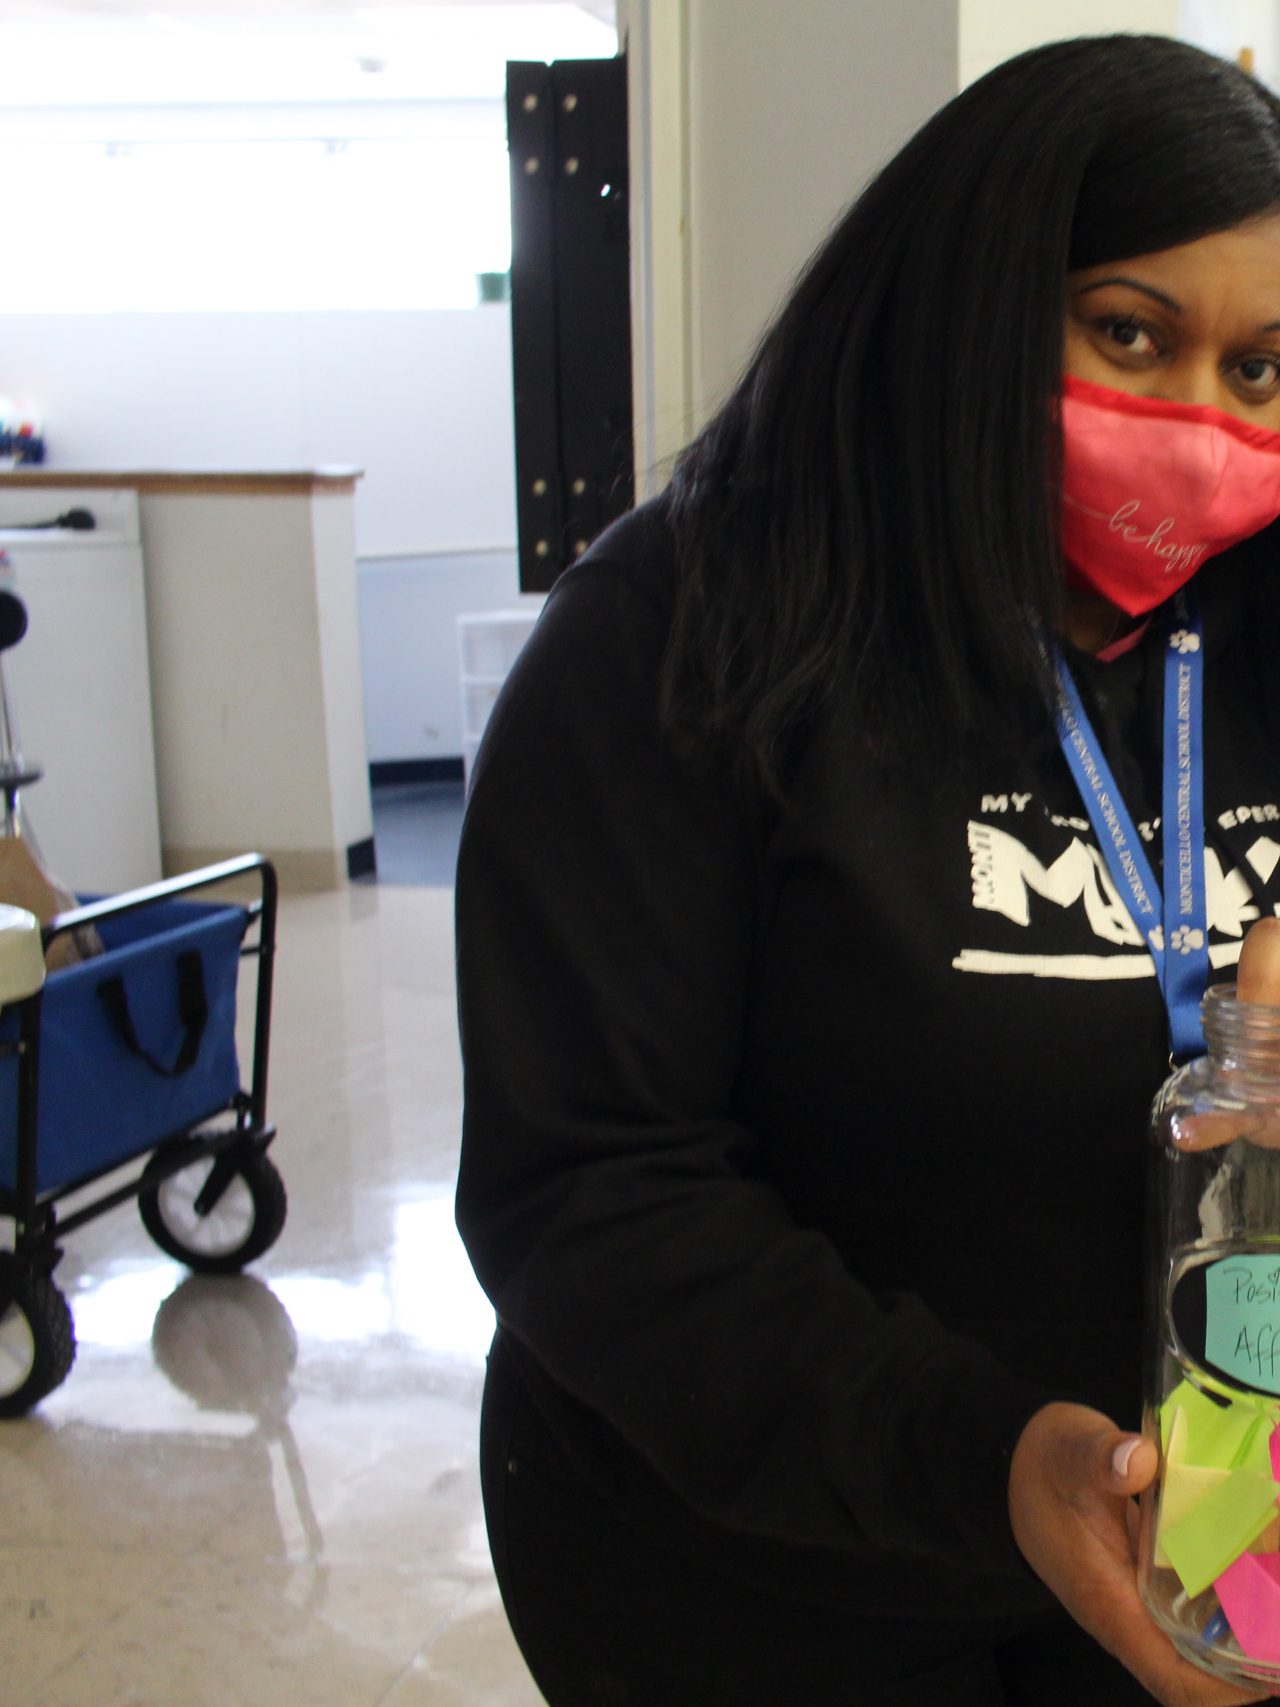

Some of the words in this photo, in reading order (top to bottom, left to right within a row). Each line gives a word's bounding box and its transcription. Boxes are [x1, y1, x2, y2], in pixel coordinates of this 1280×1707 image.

[1178, 661, 1191, 720] DISTRICT
[1178, 721, 1191, 769] SCHOOL
[981, 791, 1033, 813] MY
[1216, 803, 1280, 831] EPER
[1070, 727, 1104, 792] CENTRAL
[1097, 791, 1127, 850] SCHOOL
[1119, 848, 1154, 914] DISTRICT
[1178, 769, 1191, 824] CENTRAL
